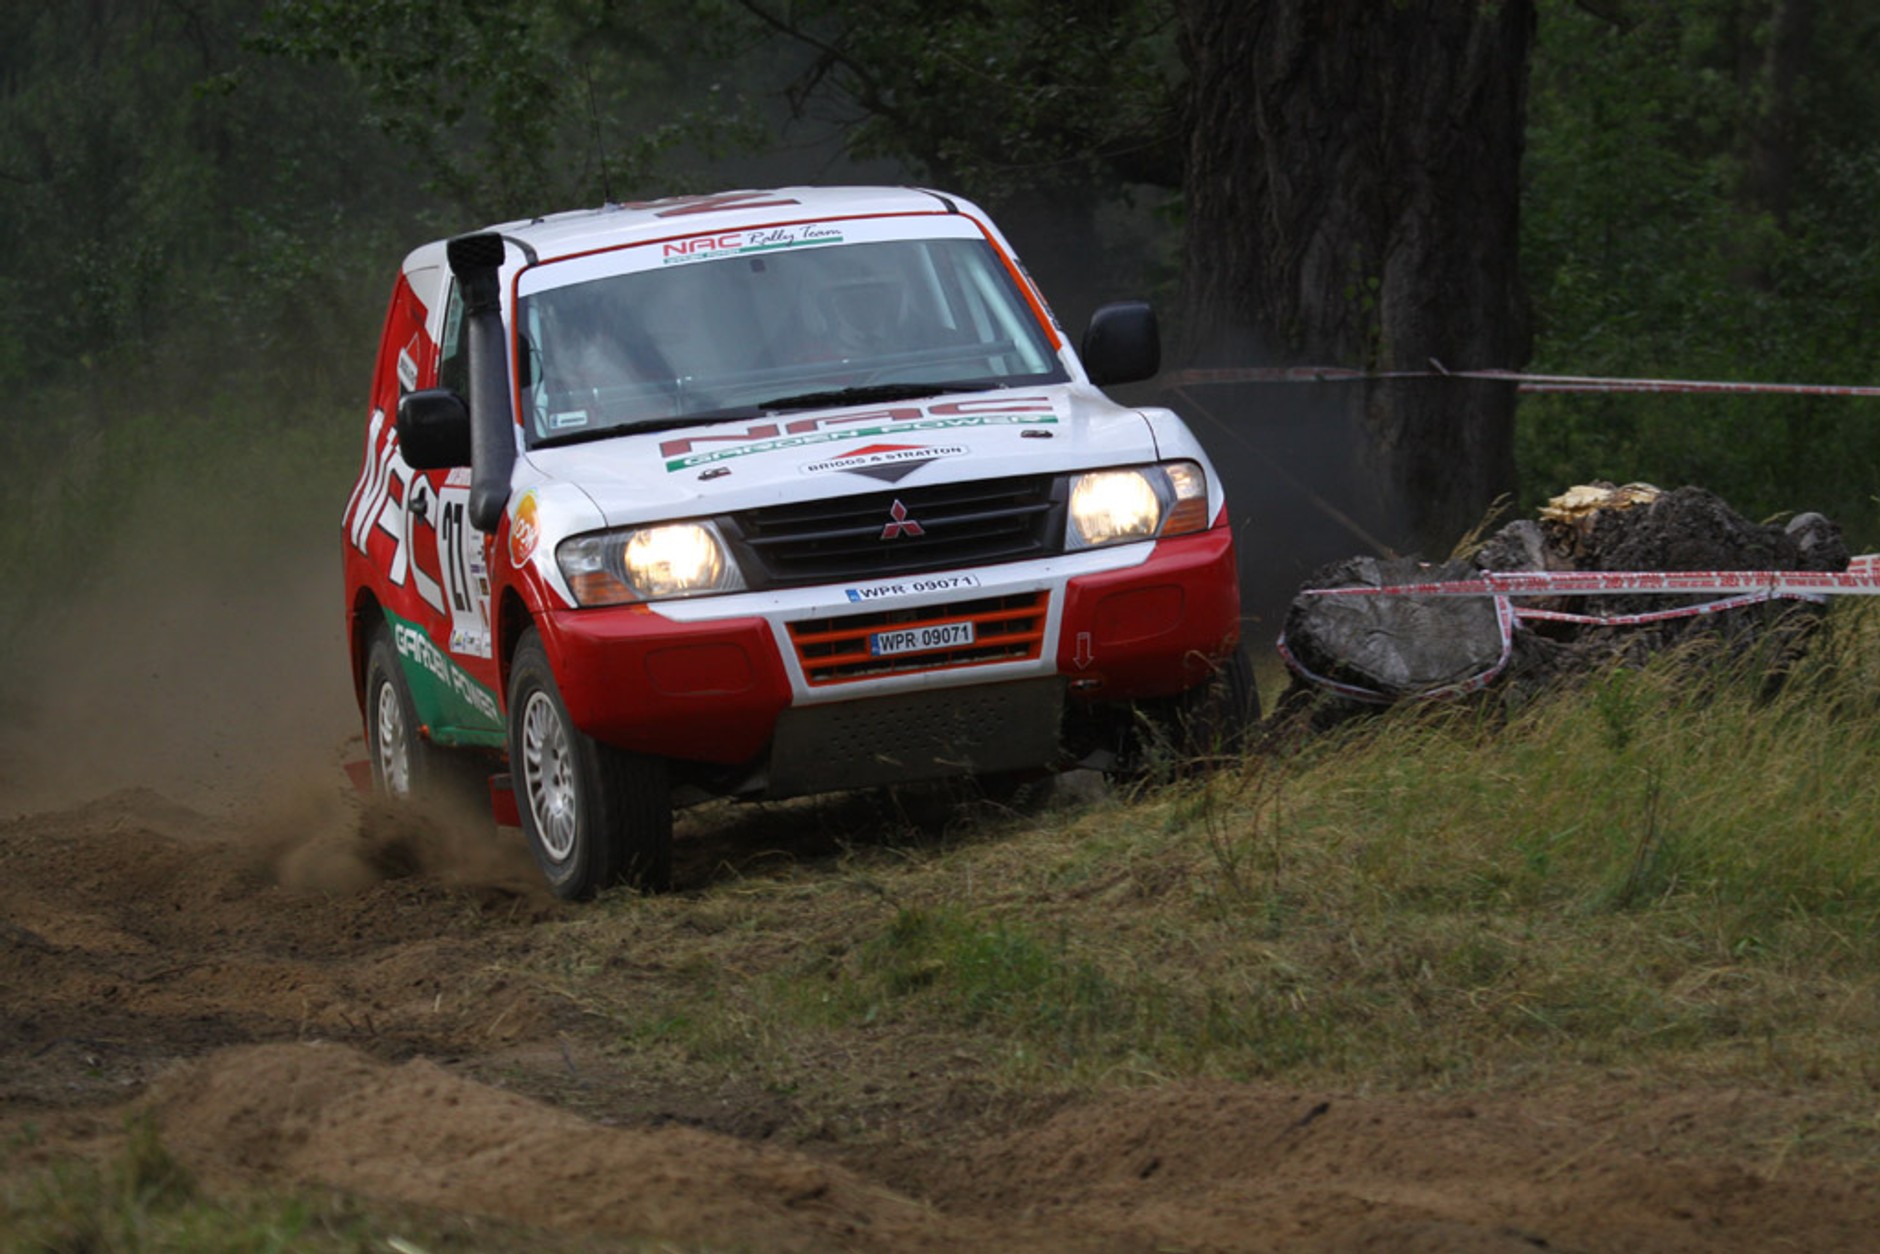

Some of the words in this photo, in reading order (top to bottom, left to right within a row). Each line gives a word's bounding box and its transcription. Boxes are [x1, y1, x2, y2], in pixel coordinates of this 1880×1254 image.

[663, 234, 743, 257] NAC
[747, 229, 794, 247] Rally
[799, 223, 843, 238] Team
[659, 396, 1053, 458] NAC
[683, 429, 860, 467] GARDEN
[880, 414, 1044, 433] POWER
[808, 458, 866, 472] BRIGGS
[885, 447, 962, 460] STRATTON
[442, 501, 473, 613] 27
[860, 585, 907, 599] WPR
[912, 576, 973, 592] 09071
[395, 623, 451, 687] GARDEN
[879, 633, 917, 652] WPR
[921, 625, 970, 647] 09071
